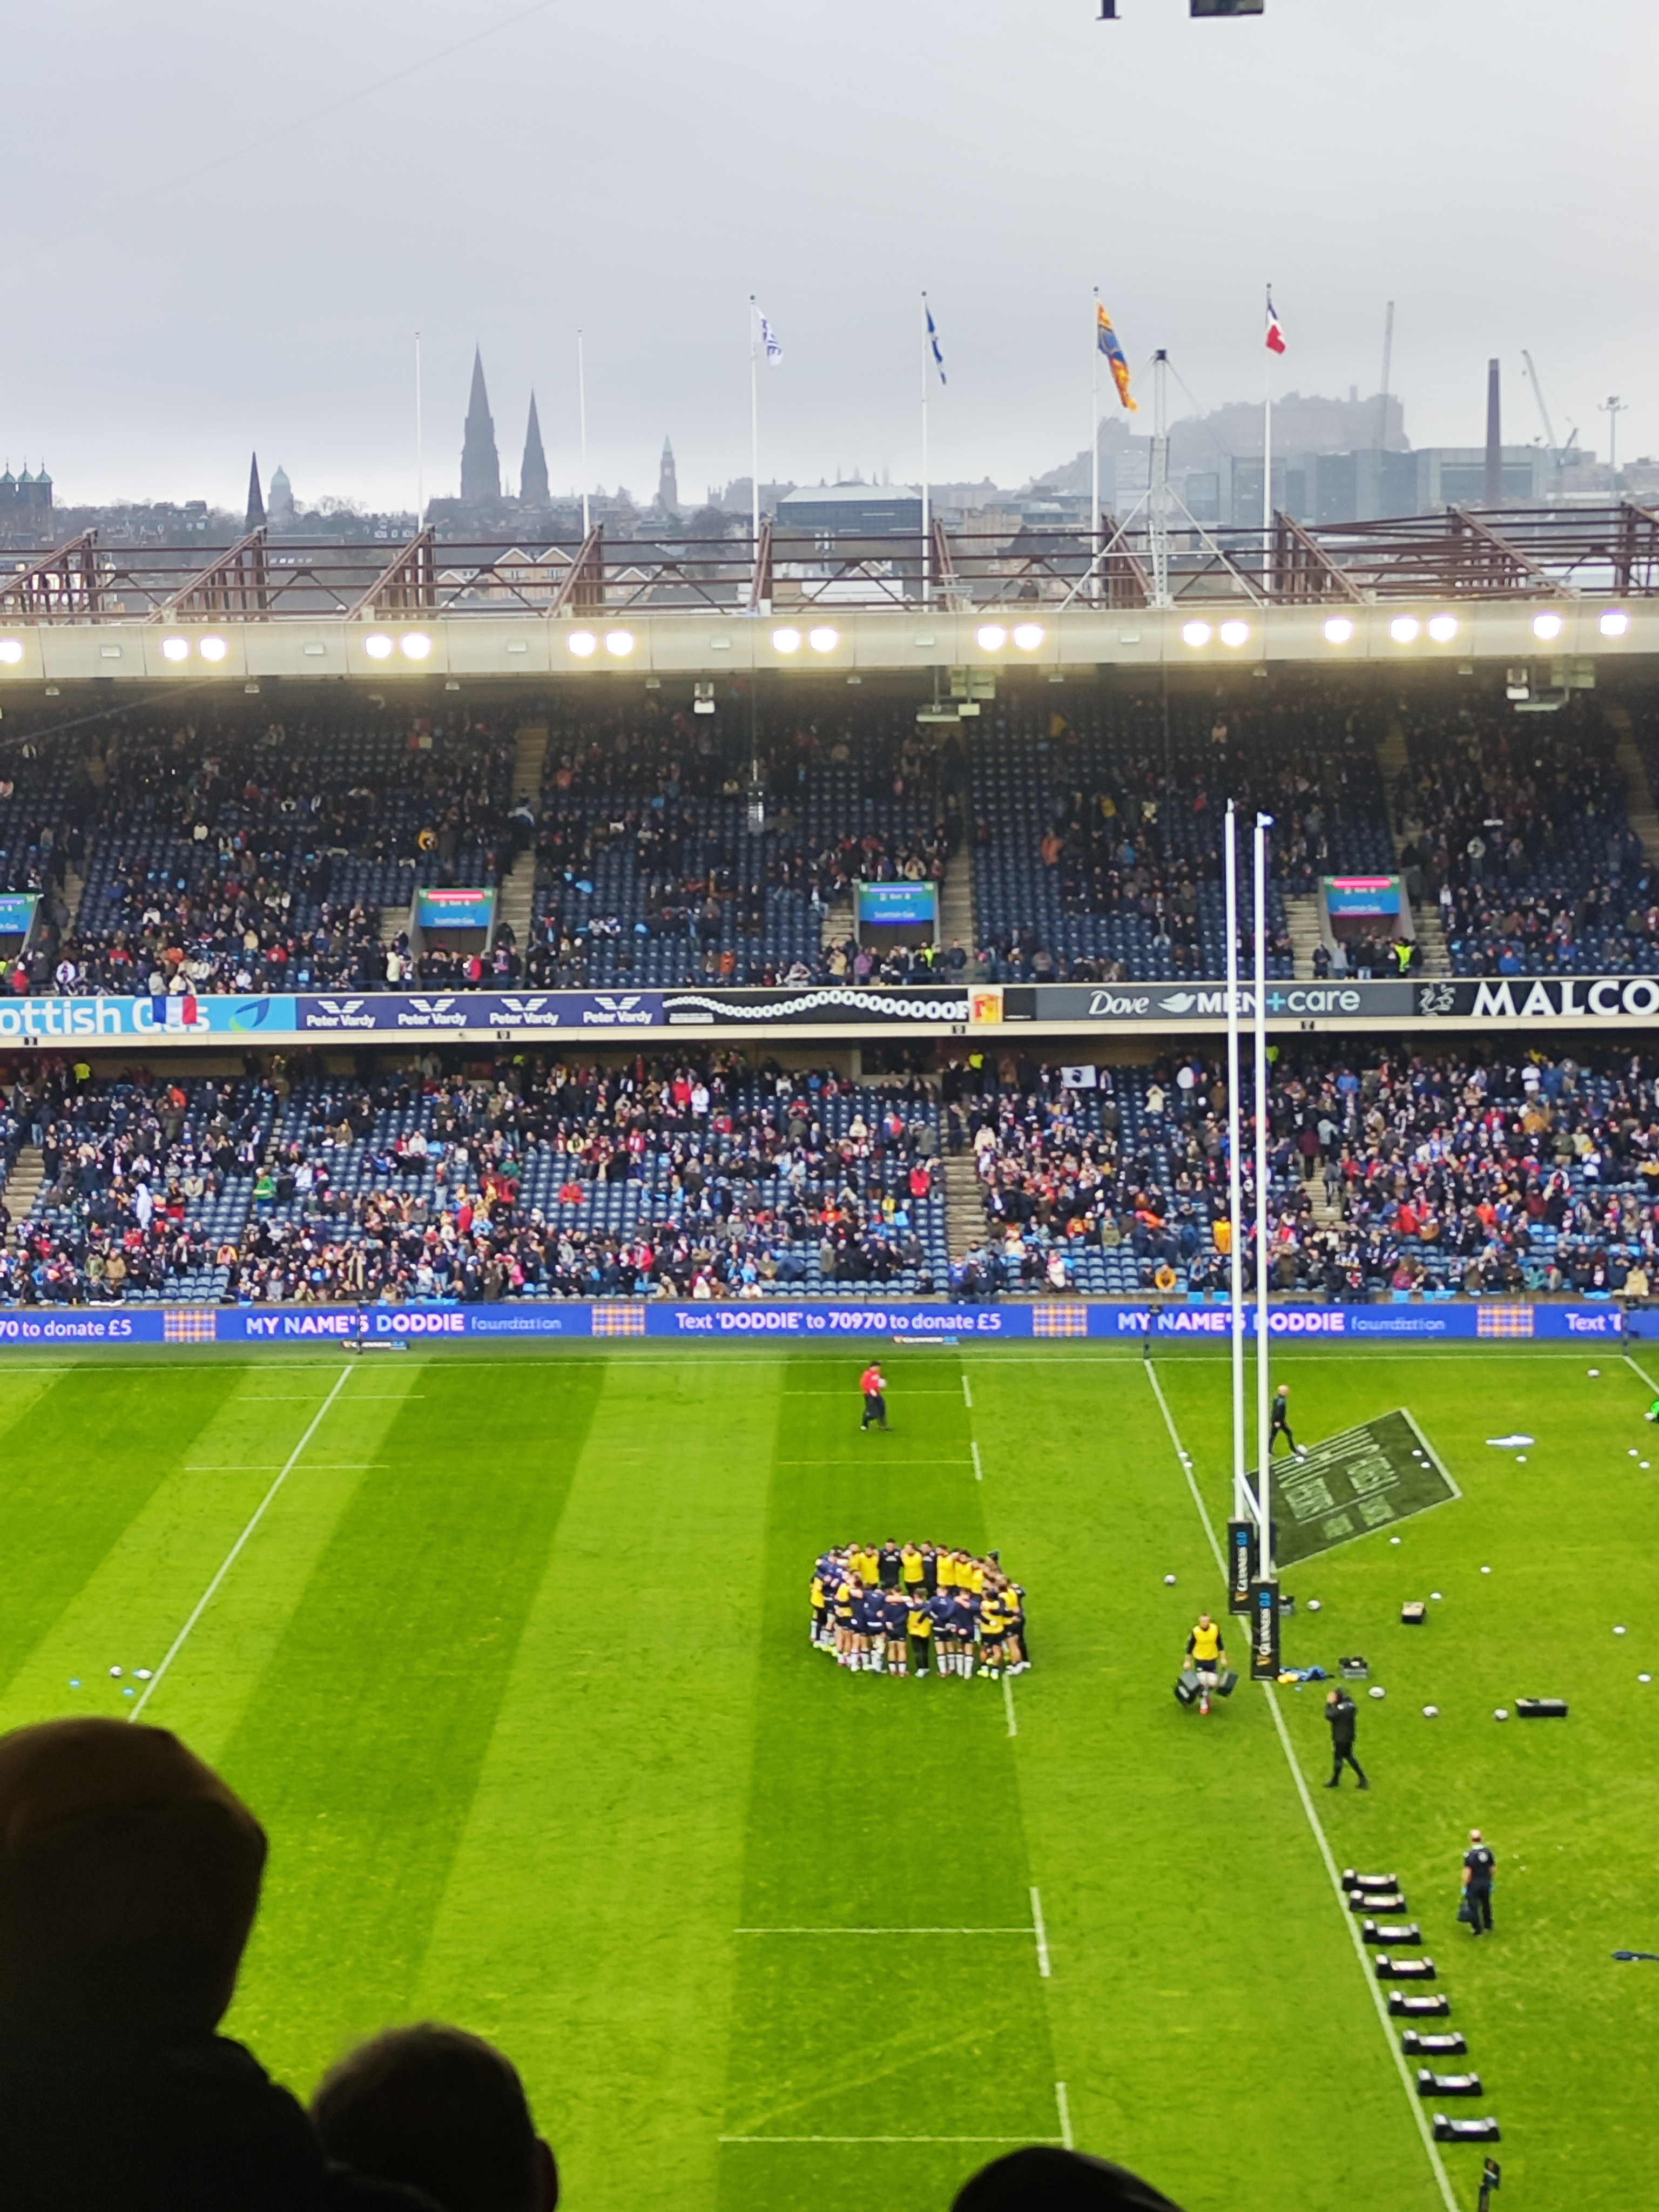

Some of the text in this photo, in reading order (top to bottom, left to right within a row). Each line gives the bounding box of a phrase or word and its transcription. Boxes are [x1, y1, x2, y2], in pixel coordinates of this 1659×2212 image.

[1088, 990, 1149, 1015] Dove
[1471, 980, 1659, 1016] MALCO
[307, 1014, 376, 1028] Peter Vardy
[398, 1013, 467, 1027] Peter Vardy
[490, 1012, 558, 1027] Peter Vardy
[583, 1010, 652, 1025] Peter Vardy
[23, 1321, 41, 1337] to
[44, 1319, 105, 1337] donate
[109, 1319, 132, 1336] £5
[246, 1317, 279, 1334] MY
[376, 1313, 464, 1332] DODDIE
[471, 1316, 562, 1330] foundation
[675, 1312, 713, 1330] Text
[806, 1314, 826, 1330] to
[828, 1312, 887, 1330] 70970
[889, 1314, 908, 1330] to
[911, 1313, 973, 1330] donate
[976, 1312, 1001, 1330] £5
[1117, 1312, 1151, 1331] MY
[1351, 1314, 1446, 1331] foundation
[1565, 1313, 1606, 1331] Text
